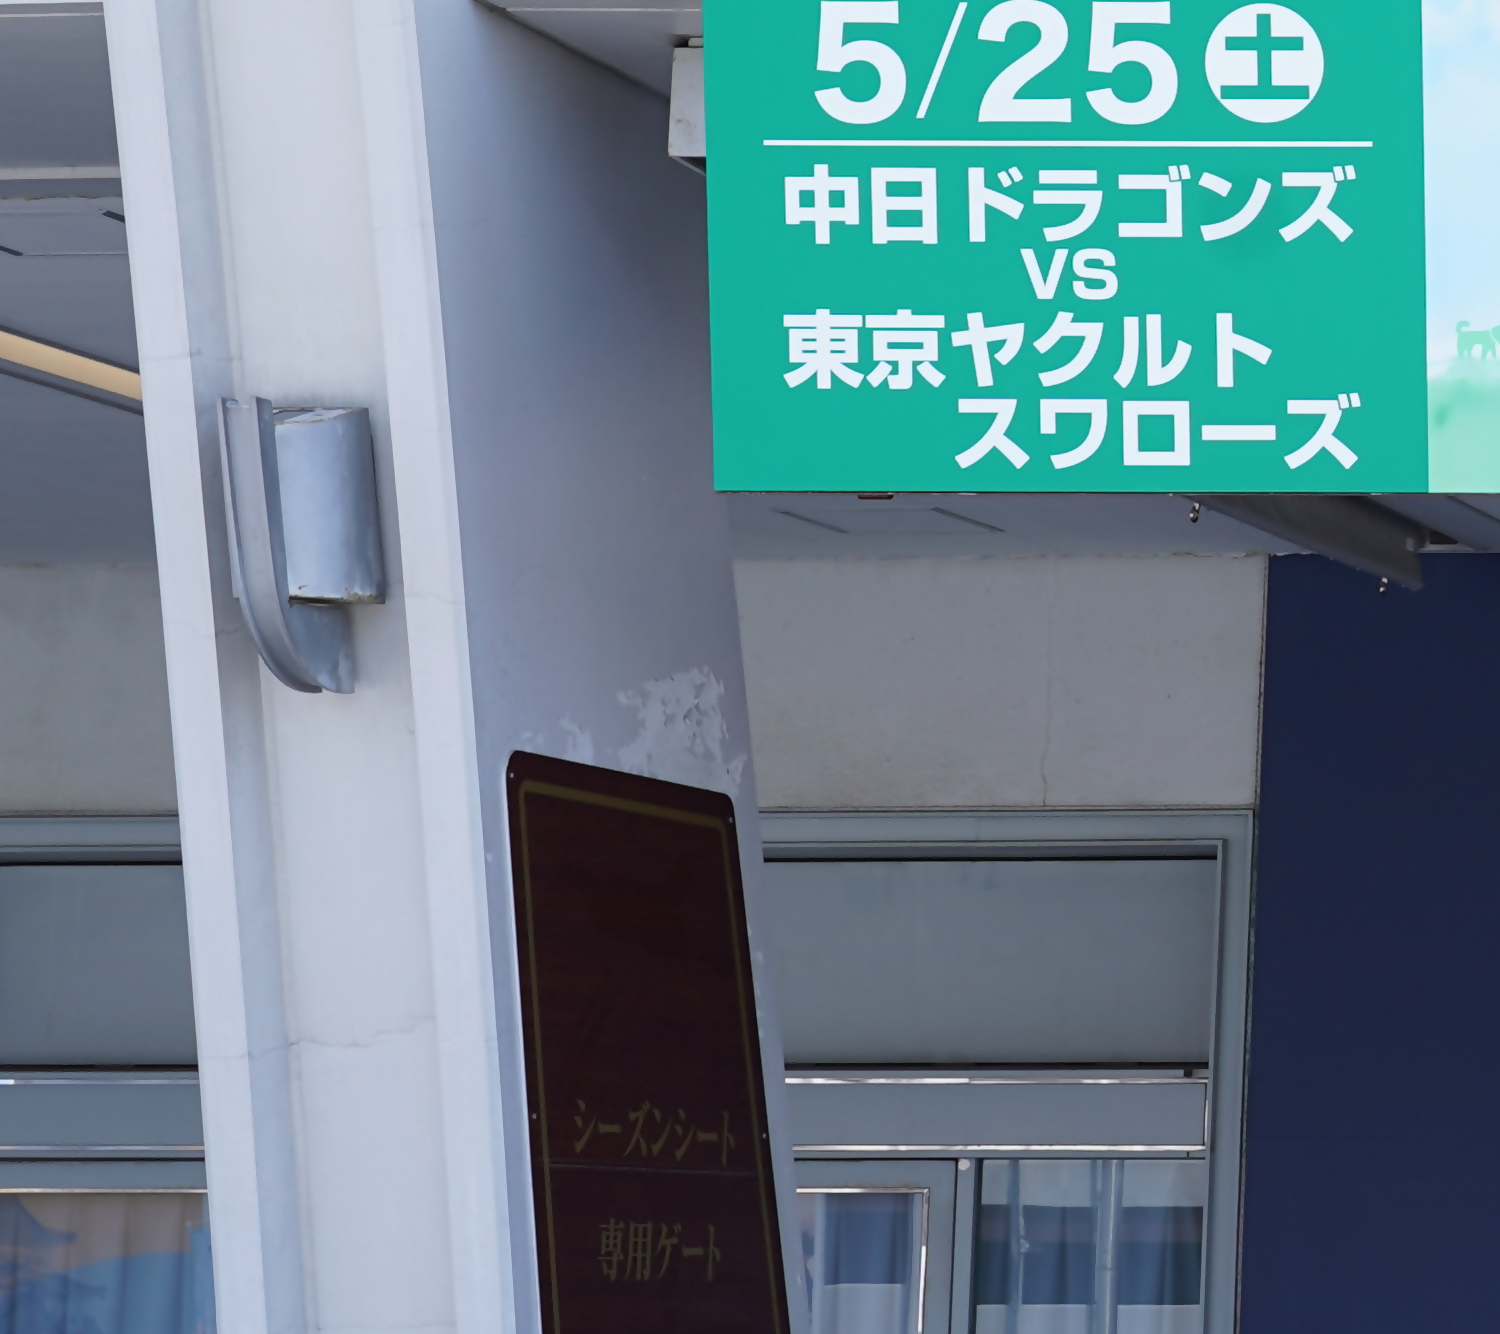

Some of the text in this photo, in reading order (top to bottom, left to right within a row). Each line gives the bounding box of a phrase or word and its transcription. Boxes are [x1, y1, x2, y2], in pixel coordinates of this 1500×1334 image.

[784, 164, 1355, 244] 中日ドラゴンズ
[1020, 248, 1119, 300] VS
[783, 309, 1272, 390] 東京ヤクルト
[955, 393, 1361, 469] スワローズ
[573, 1098, 736, 1166] シーズンシート
[597, 1217, 721, 1282] 専用ゲート
